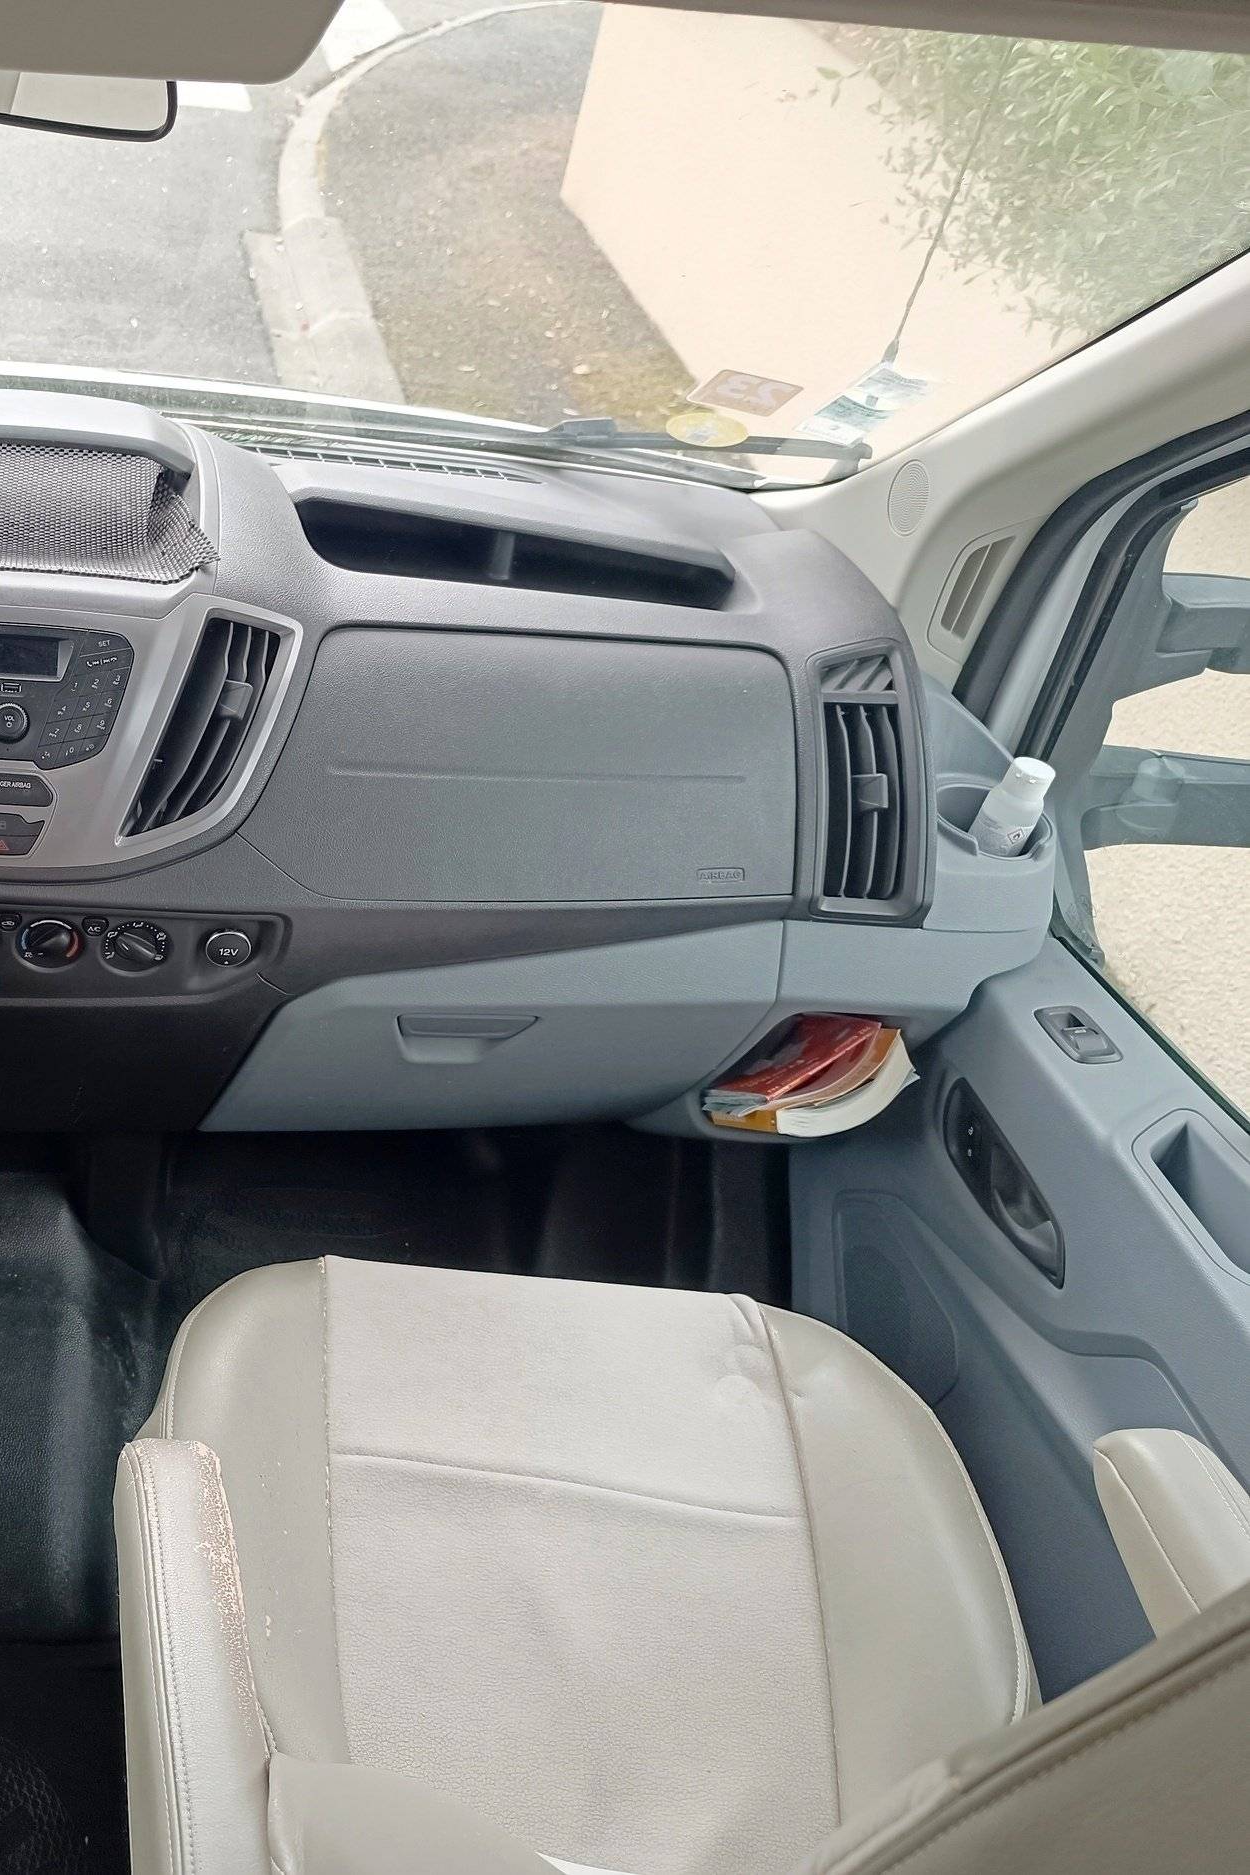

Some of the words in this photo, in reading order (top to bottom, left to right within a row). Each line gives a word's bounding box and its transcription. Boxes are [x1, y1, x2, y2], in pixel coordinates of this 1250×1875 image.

[12, 781, 31, 789] AIRBAG
[700, 870, 742, 881] AIRBAG
[219, 948, 239, 956] 12V
